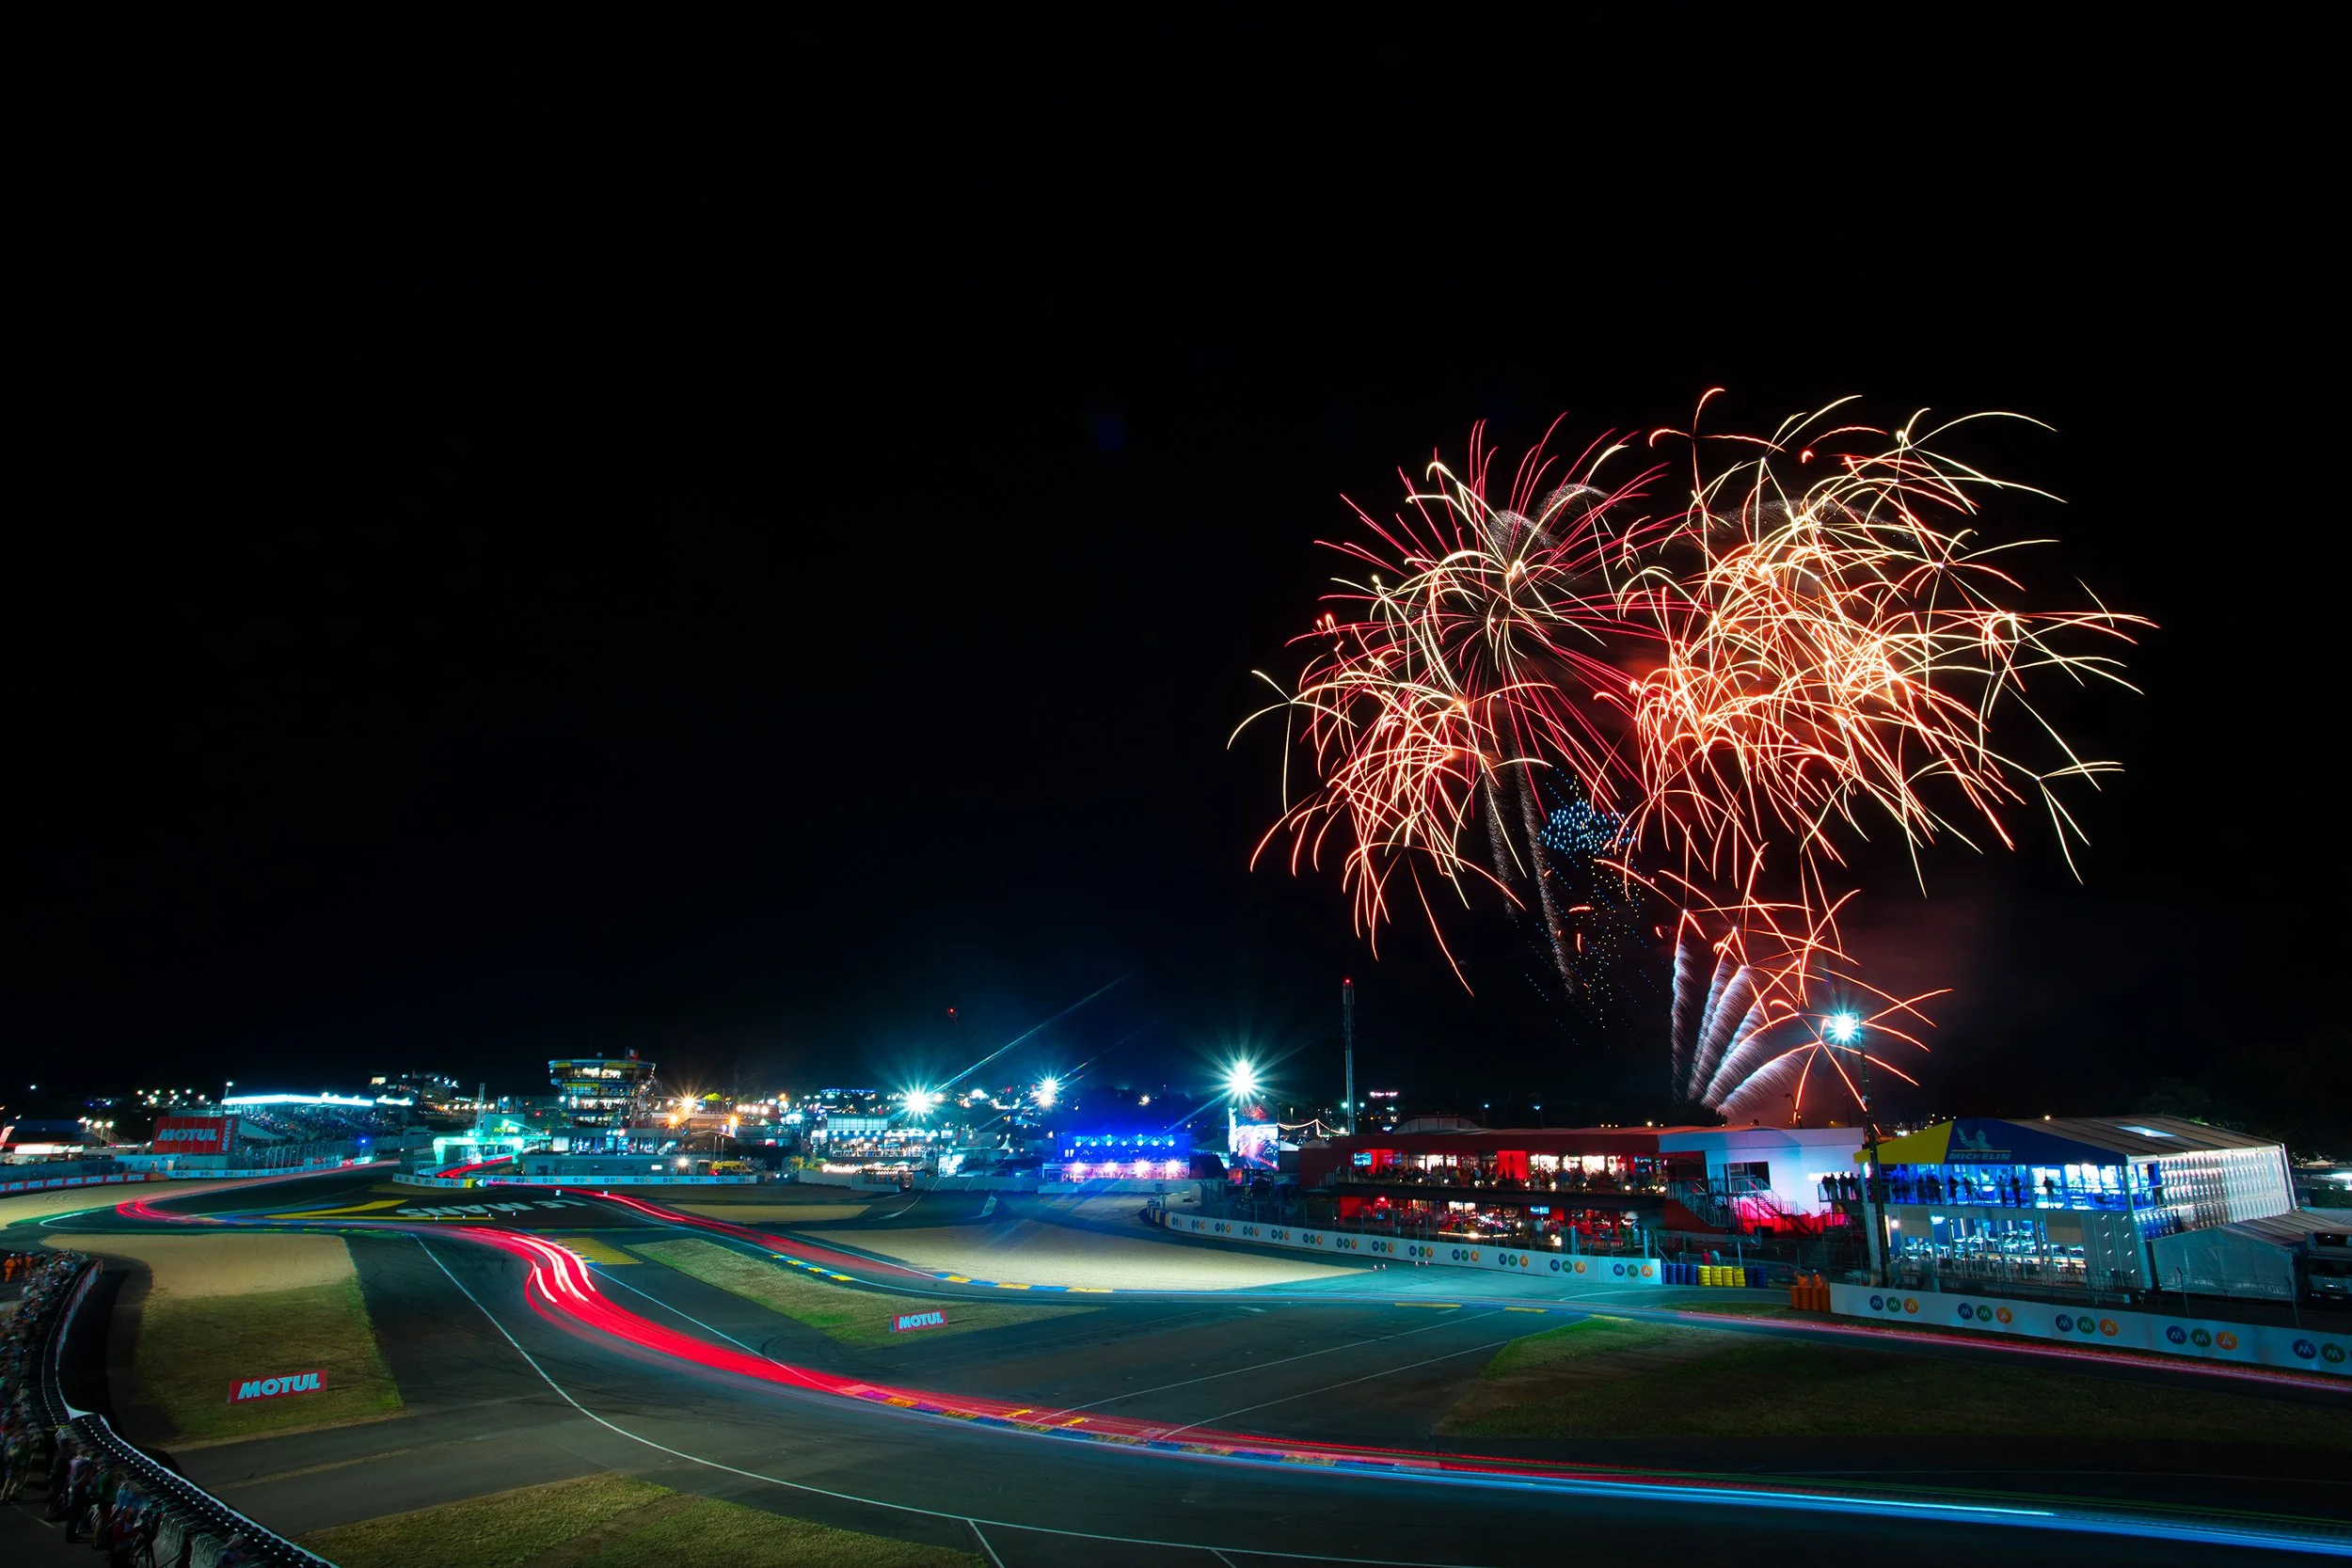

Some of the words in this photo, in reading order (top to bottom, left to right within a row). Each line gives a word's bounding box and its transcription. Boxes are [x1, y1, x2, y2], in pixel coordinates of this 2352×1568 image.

[157, 1129, 217, 1141] MOTUL
[222, 1118, 232, 1151] MOTUL
[395, 1202, 535, 1217] MANS
[532, 1199, 587, 1209] LE
[1551, 1260, 1585, 1273] MMA
[1614, 1265, 1651, 1276] MMA
[1871, 1297, 1916, 1312] MMA
[898, 1311, 944, 1329] MOTUL
[1959, 1306, 2010, 1323] MMA
[2058, 1317, 2116, 1335] MMA
[2169, 1328, 2234, 1348] MMA
[237, 1372, 321, 1400] MOTUL
